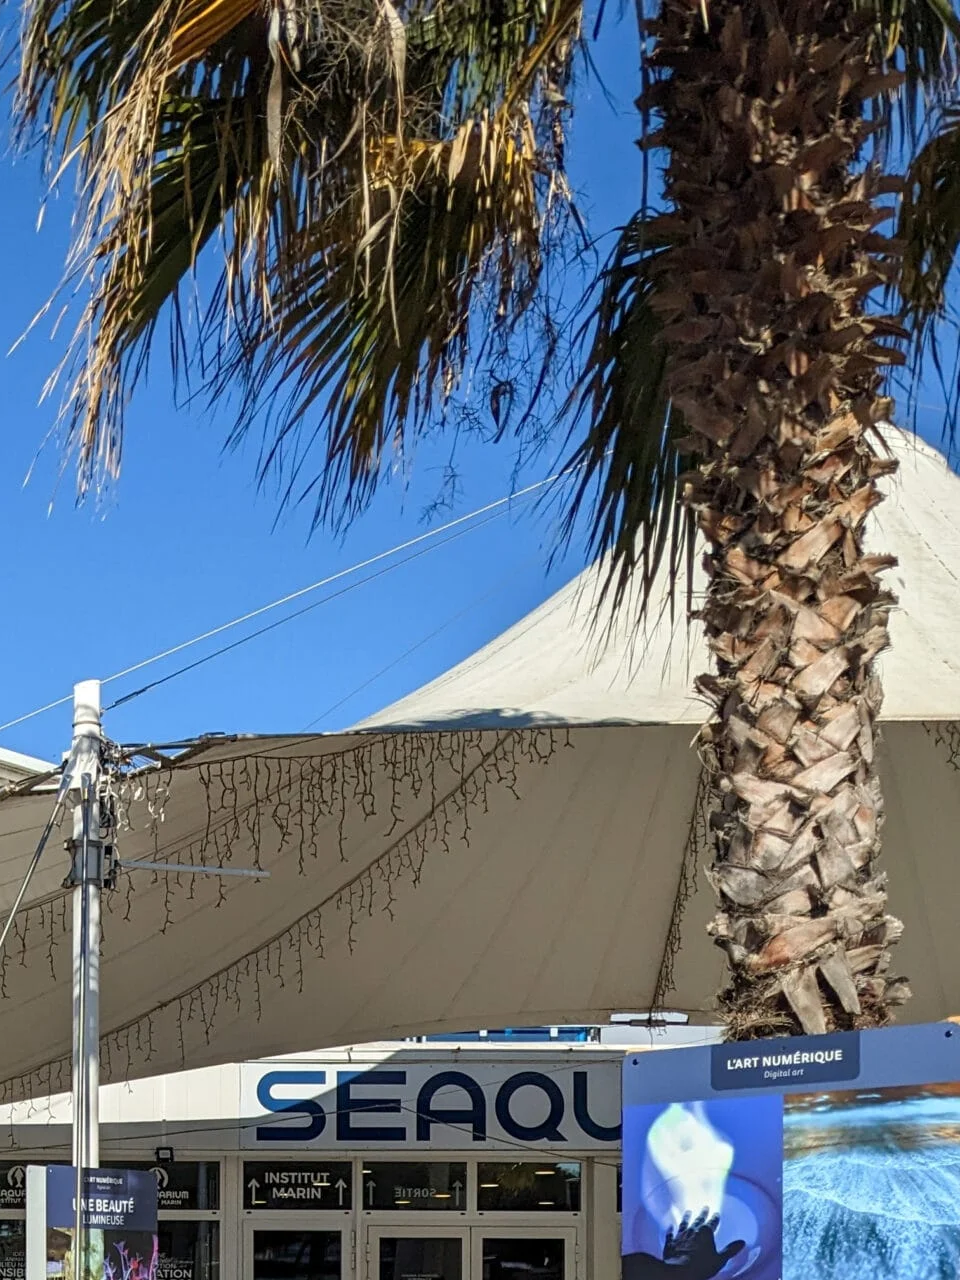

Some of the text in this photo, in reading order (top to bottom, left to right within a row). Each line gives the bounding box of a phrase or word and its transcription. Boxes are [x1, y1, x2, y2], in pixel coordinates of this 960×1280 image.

[727, 1049, 843, 1070] L'ART NUMÉRIQUE
[764, 1068, 804, 1080] Digital art
[256, 1070, 623, 1142] SEAQU
[264, 1172, 330, 1184] INSTITUT
[158, 1190, 189, 1200] ARIUM
[272, 1187, 322, 1199] MARIN
[96, 1197, 134, 1213] BEAUTÉ
[83, 1215, 124, 1225] LUMINEUSE
